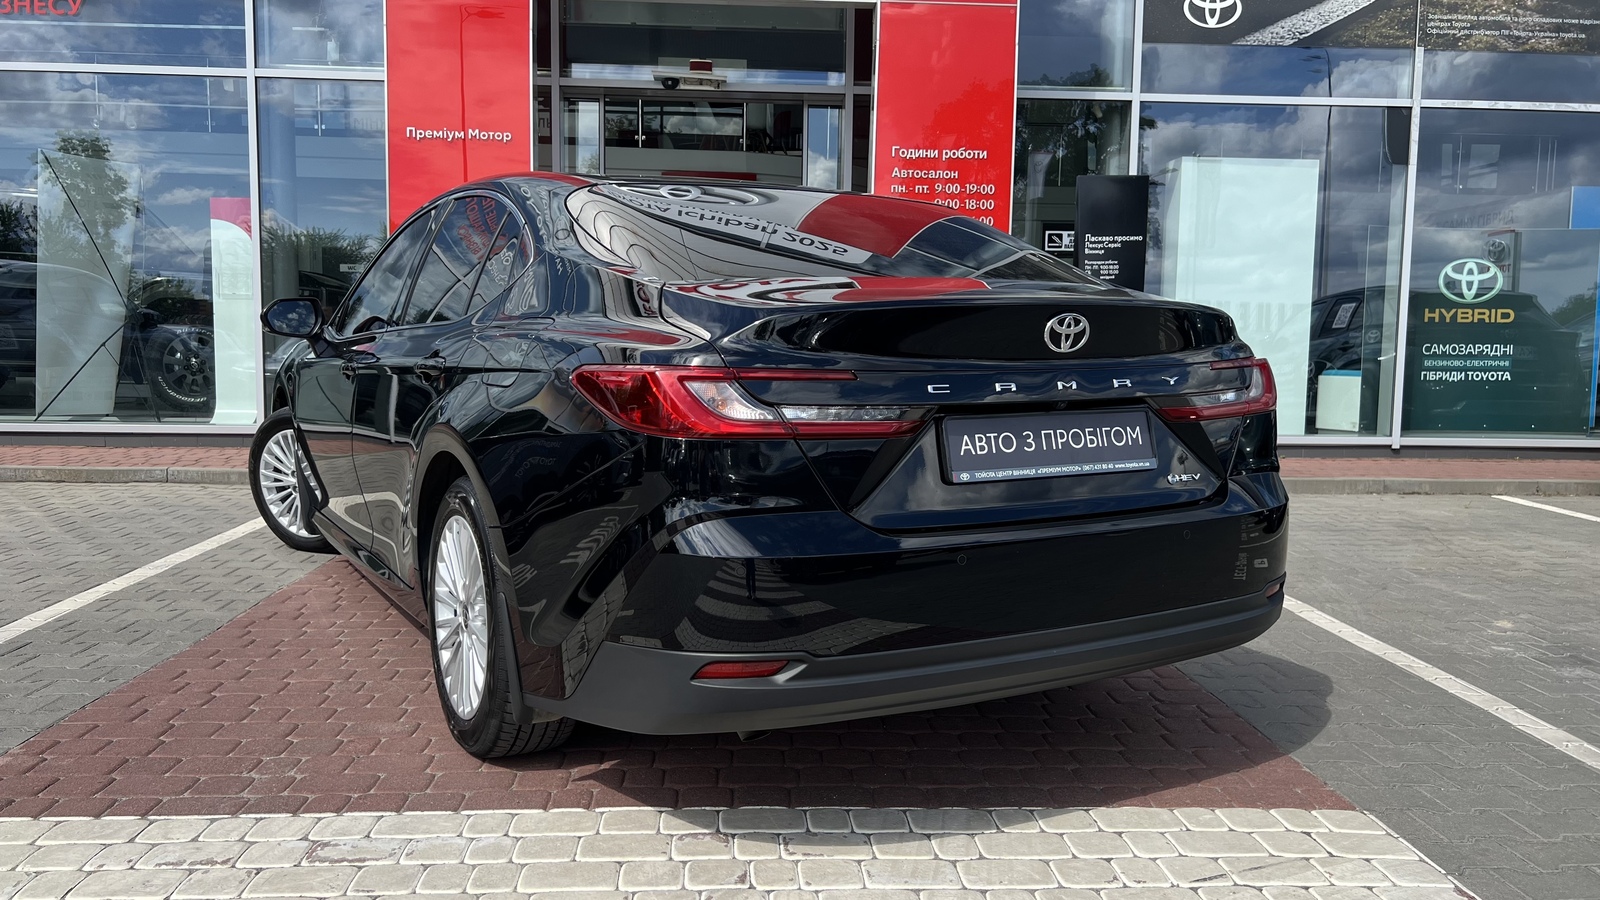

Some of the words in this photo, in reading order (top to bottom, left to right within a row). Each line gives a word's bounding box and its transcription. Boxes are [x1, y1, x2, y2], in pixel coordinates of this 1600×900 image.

[406, 127, 465, 142] Преміум
[468, 128, 512, 143] Мотор
[891, 146, 939, 160] Години
[942, 147, 988, 161] роботи
[891, 167, 959, 179] Автосалон
[934, 183, 996, 195] 9:00-19:00
[1085, 233, 1114, 242] Ласкаво
[1114, 235, 1143, 243] просимо
[1423, 308, 1516, 323] HYBRID
[1422, 343, 1514, 356] САМОЗАРЯДНІ
[1423, 359, 1510, 367] БЕНЗИНОВО-ЕЛЕКТРИЧНІ
[1420, 371, 1465, 382] ГІБРИДИ
[1466, 371, 1512, 381] TOYOTA
[927, 375, 1180, 394] CAMRY
[960, 432, 1018, 456] АВТО
[1041, 425, 1144, 451] ПРОБІГОМ
[974, 471, 996, 479] ТОЙОТА
[996, 470, 1012, 478] ЦЕНТР
